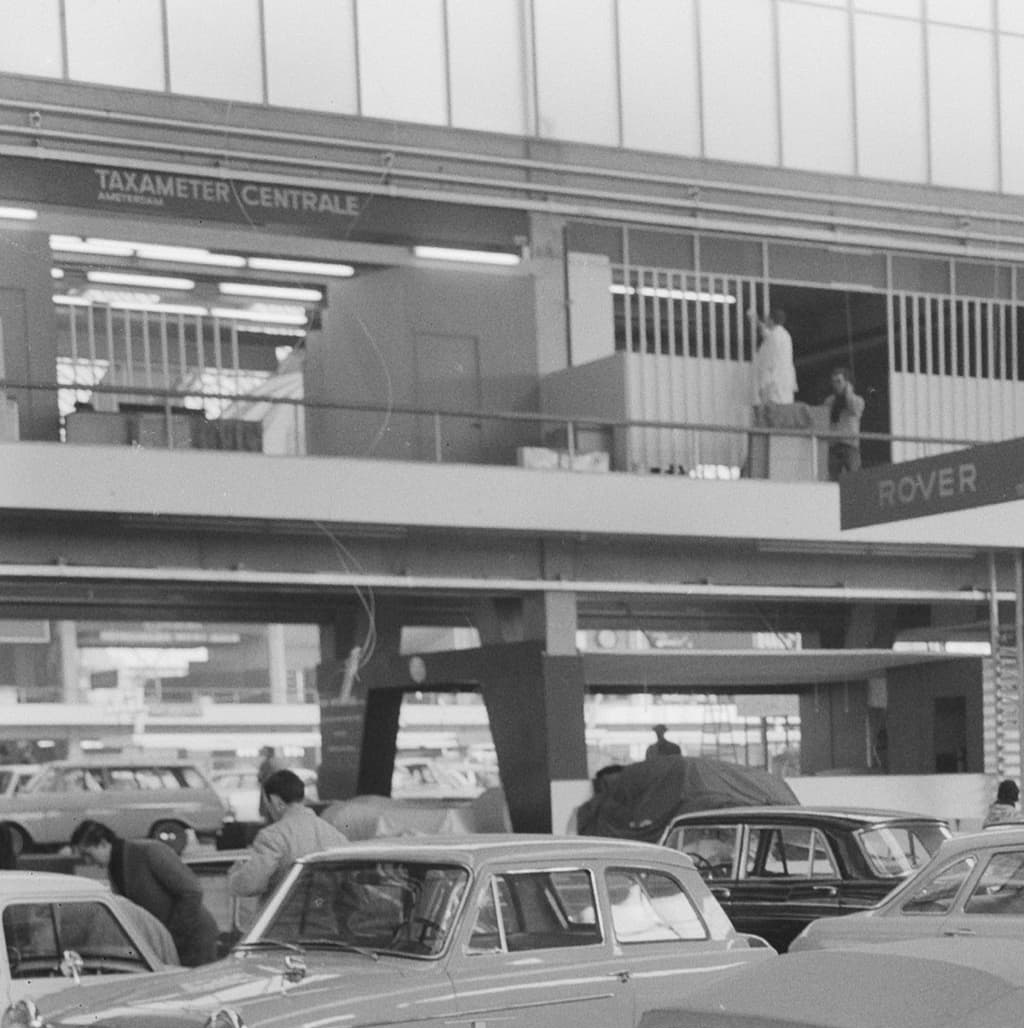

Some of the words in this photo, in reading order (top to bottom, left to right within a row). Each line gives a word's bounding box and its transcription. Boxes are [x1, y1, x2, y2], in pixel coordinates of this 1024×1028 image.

[95, 169, 230, 202] TAXAMETER
[241, 186, 360, 216] CENTRALE
[877, 463, 977, 506] ROVER
